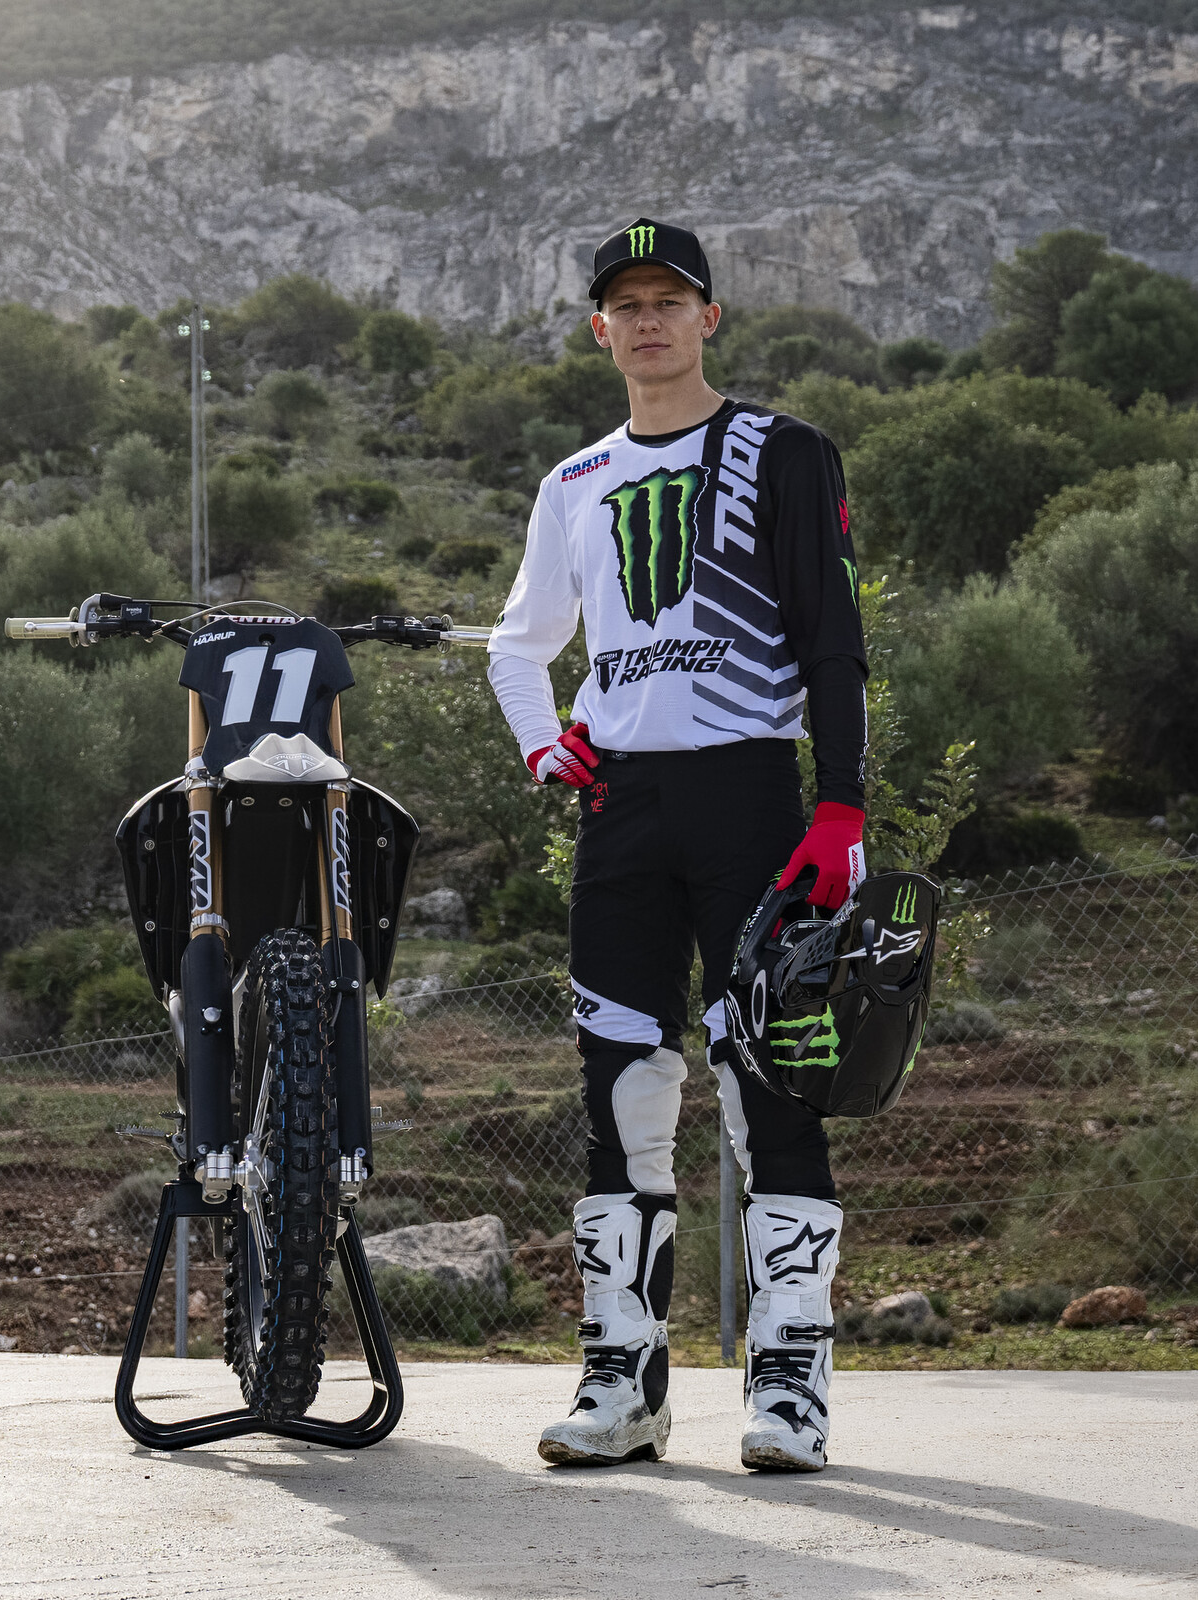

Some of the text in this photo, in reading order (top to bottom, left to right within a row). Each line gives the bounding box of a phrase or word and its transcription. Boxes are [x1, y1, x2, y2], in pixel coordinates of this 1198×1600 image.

[561, 458, 610, 482] EUROPE
[562, 450, 610, 477] PARTS
[713, 412, 775, 555] THOR
[193, 631, 236, 646] HAARUP
[624, 639, 732, 669] TRIUMPH
[221, 646, 317, 727] 11
[617, 656, 724, 687] RACING
[851, 848, 859, 882] THOR
